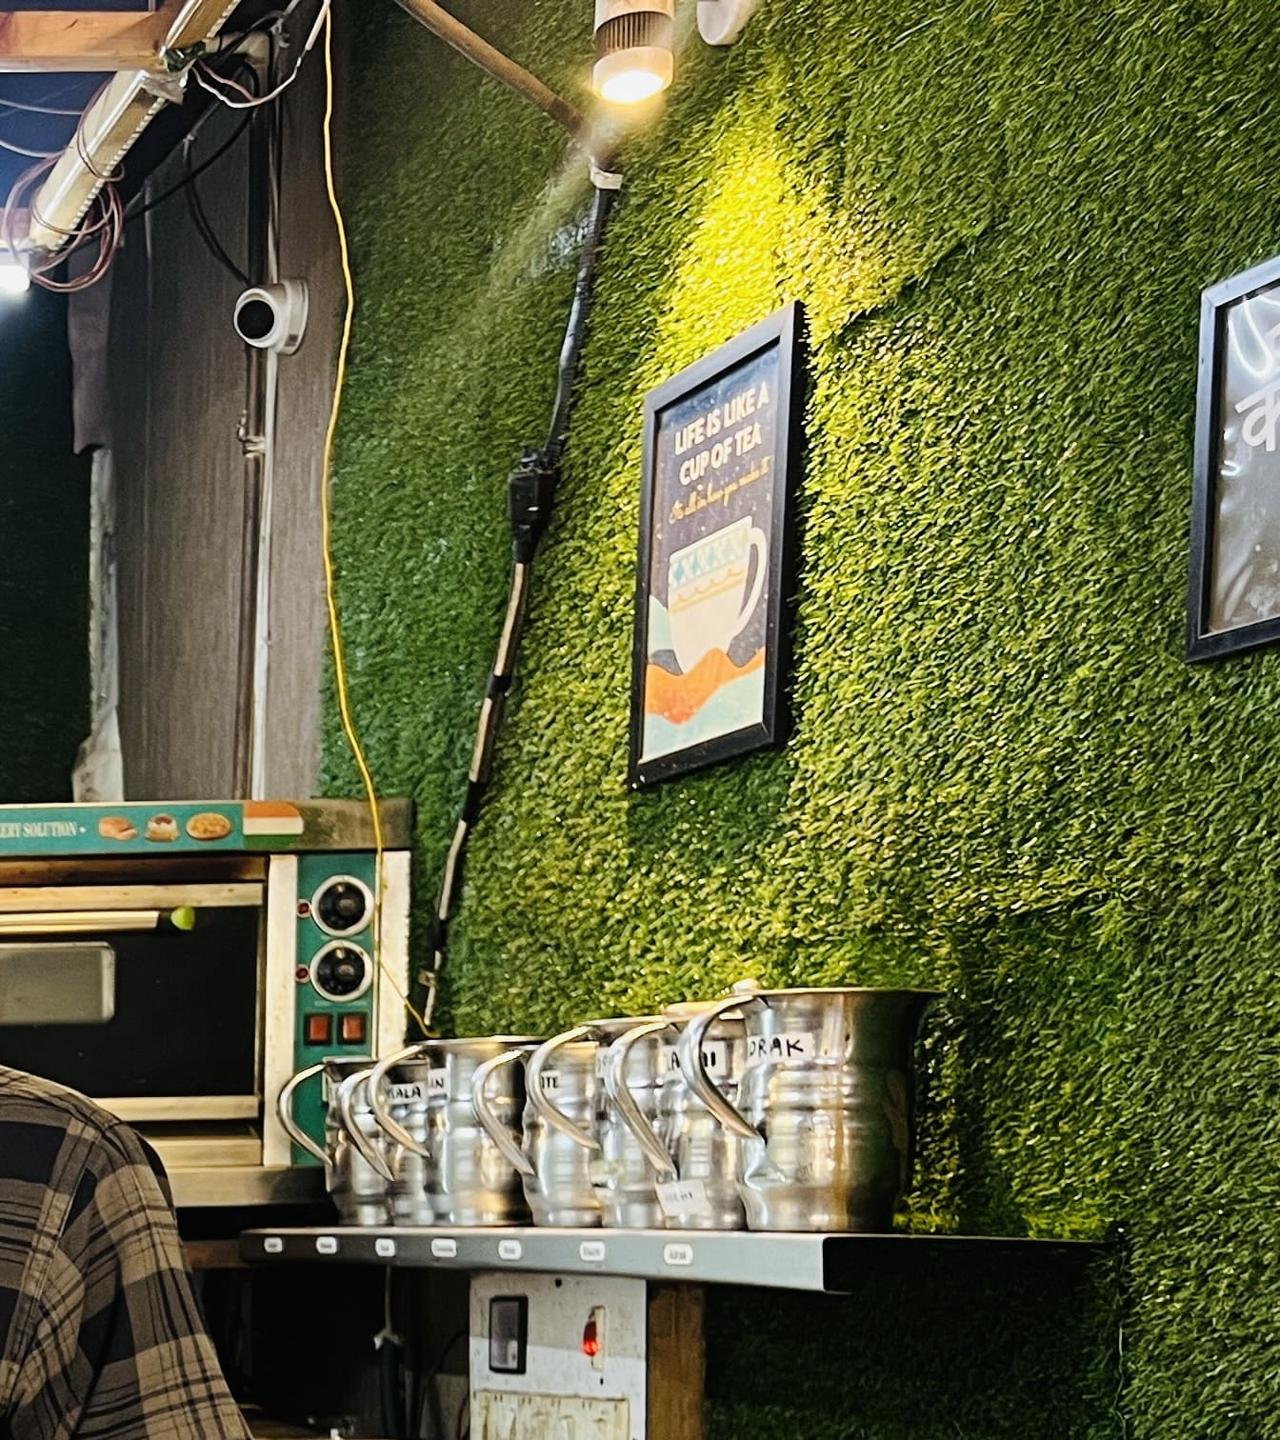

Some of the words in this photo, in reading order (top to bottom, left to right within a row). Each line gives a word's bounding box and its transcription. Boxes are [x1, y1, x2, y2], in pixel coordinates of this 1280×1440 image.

[675, 417, 705, 456] LIFE
[706, 408, 721, 438] IS
[723, 387, 756, 428] LIKE
[757, 380, 769, 409] A
[680, 450, 710, 486] CUP
[711, 436, 734, 469] OF
[735, 421, 762, 456] TEA
[23, 821, 77, 838] SOLUTION
[748, 1035, 805, 1058] DRAK
